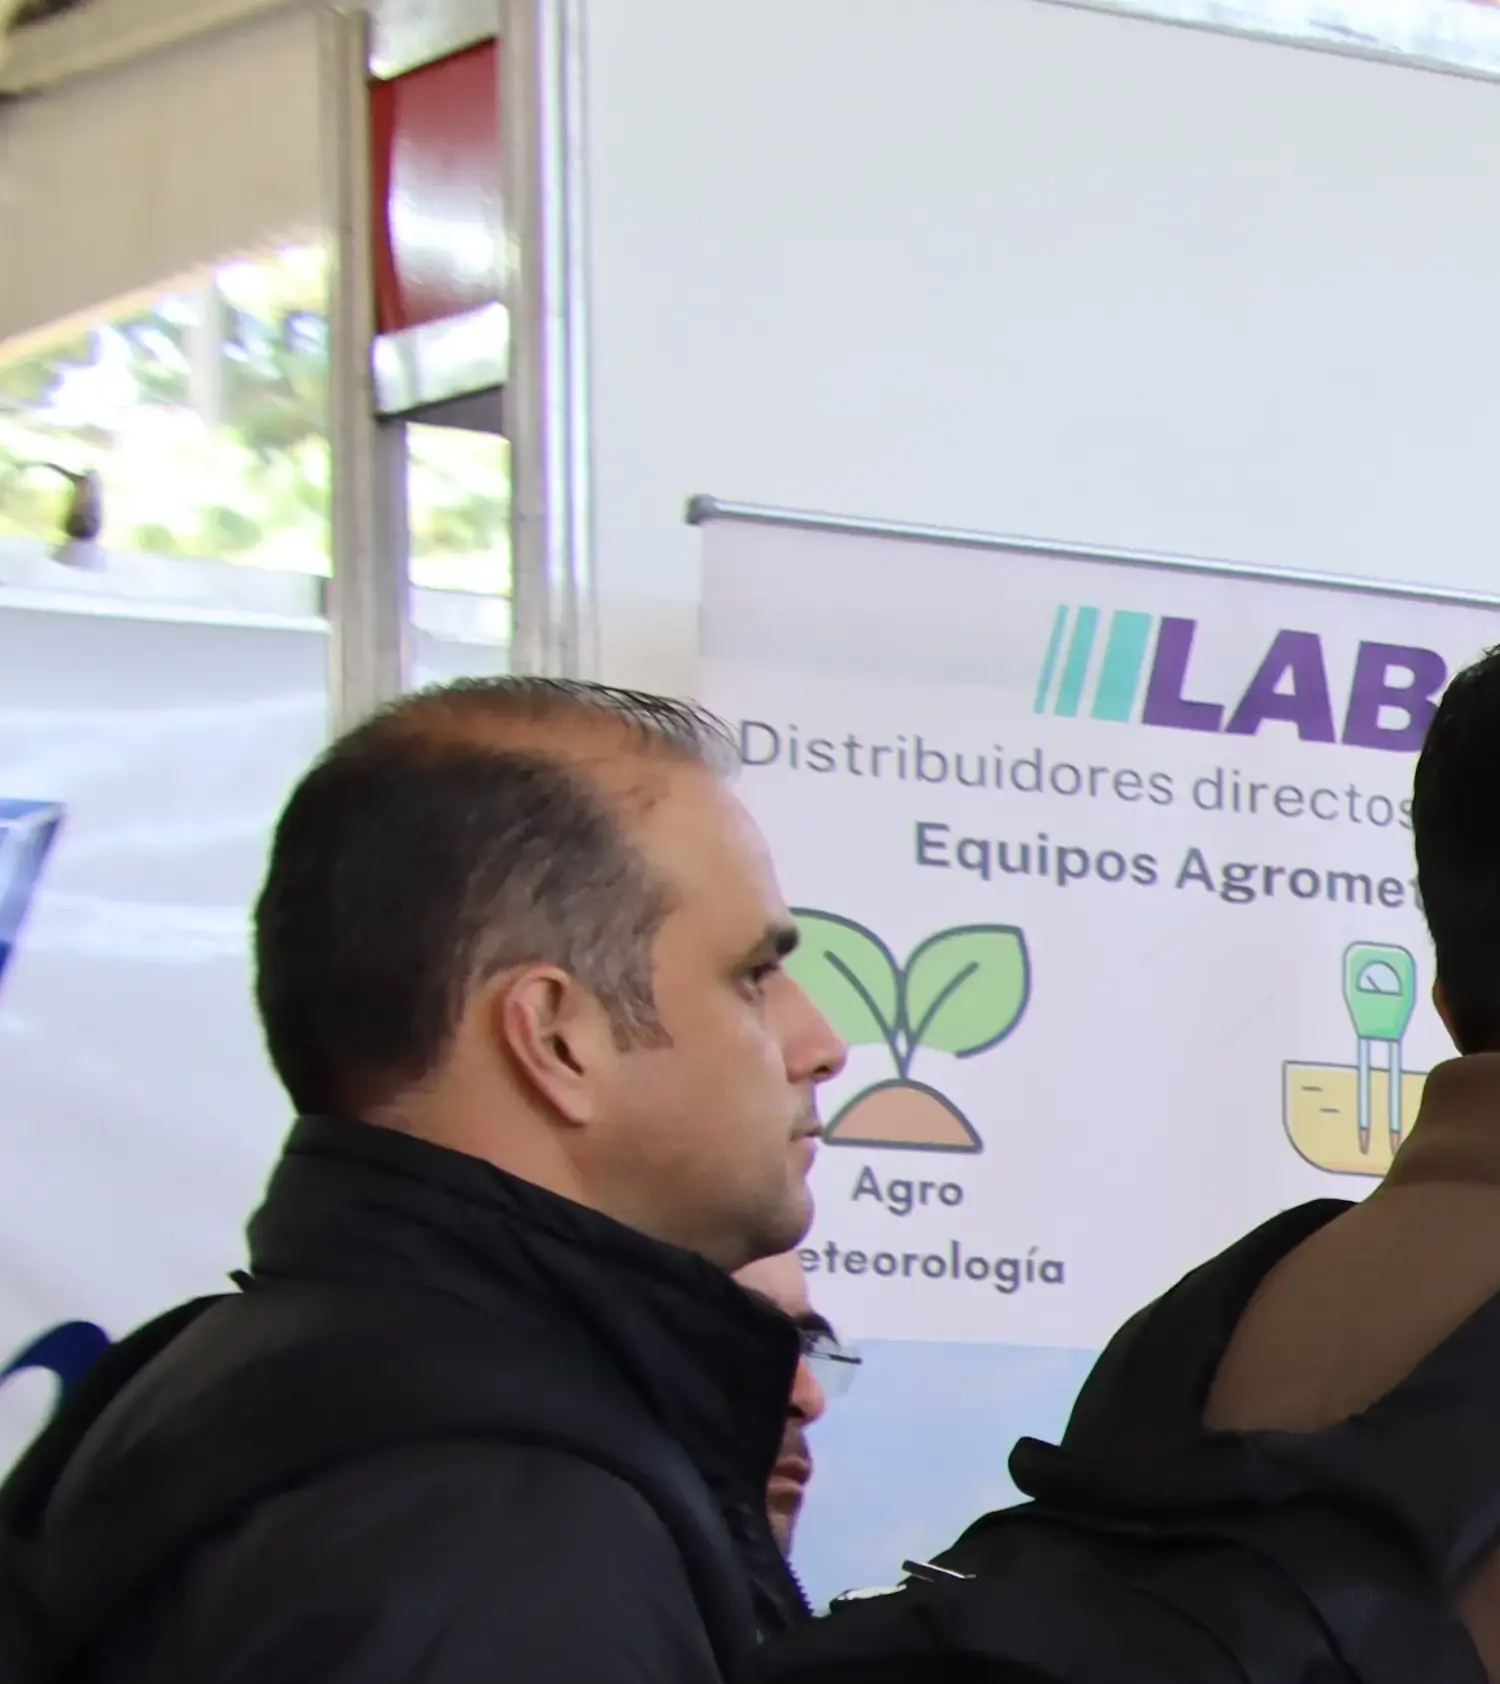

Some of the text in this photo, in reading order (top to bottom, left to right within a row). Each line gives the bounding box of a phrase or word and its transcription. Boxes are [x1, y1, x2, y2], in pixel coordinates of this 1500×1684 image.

[738, 719, 1174, 807] Distribuidores
[914, 821, 1158, 886] Equipos
[852, 1165, 964, 1216] Agro
